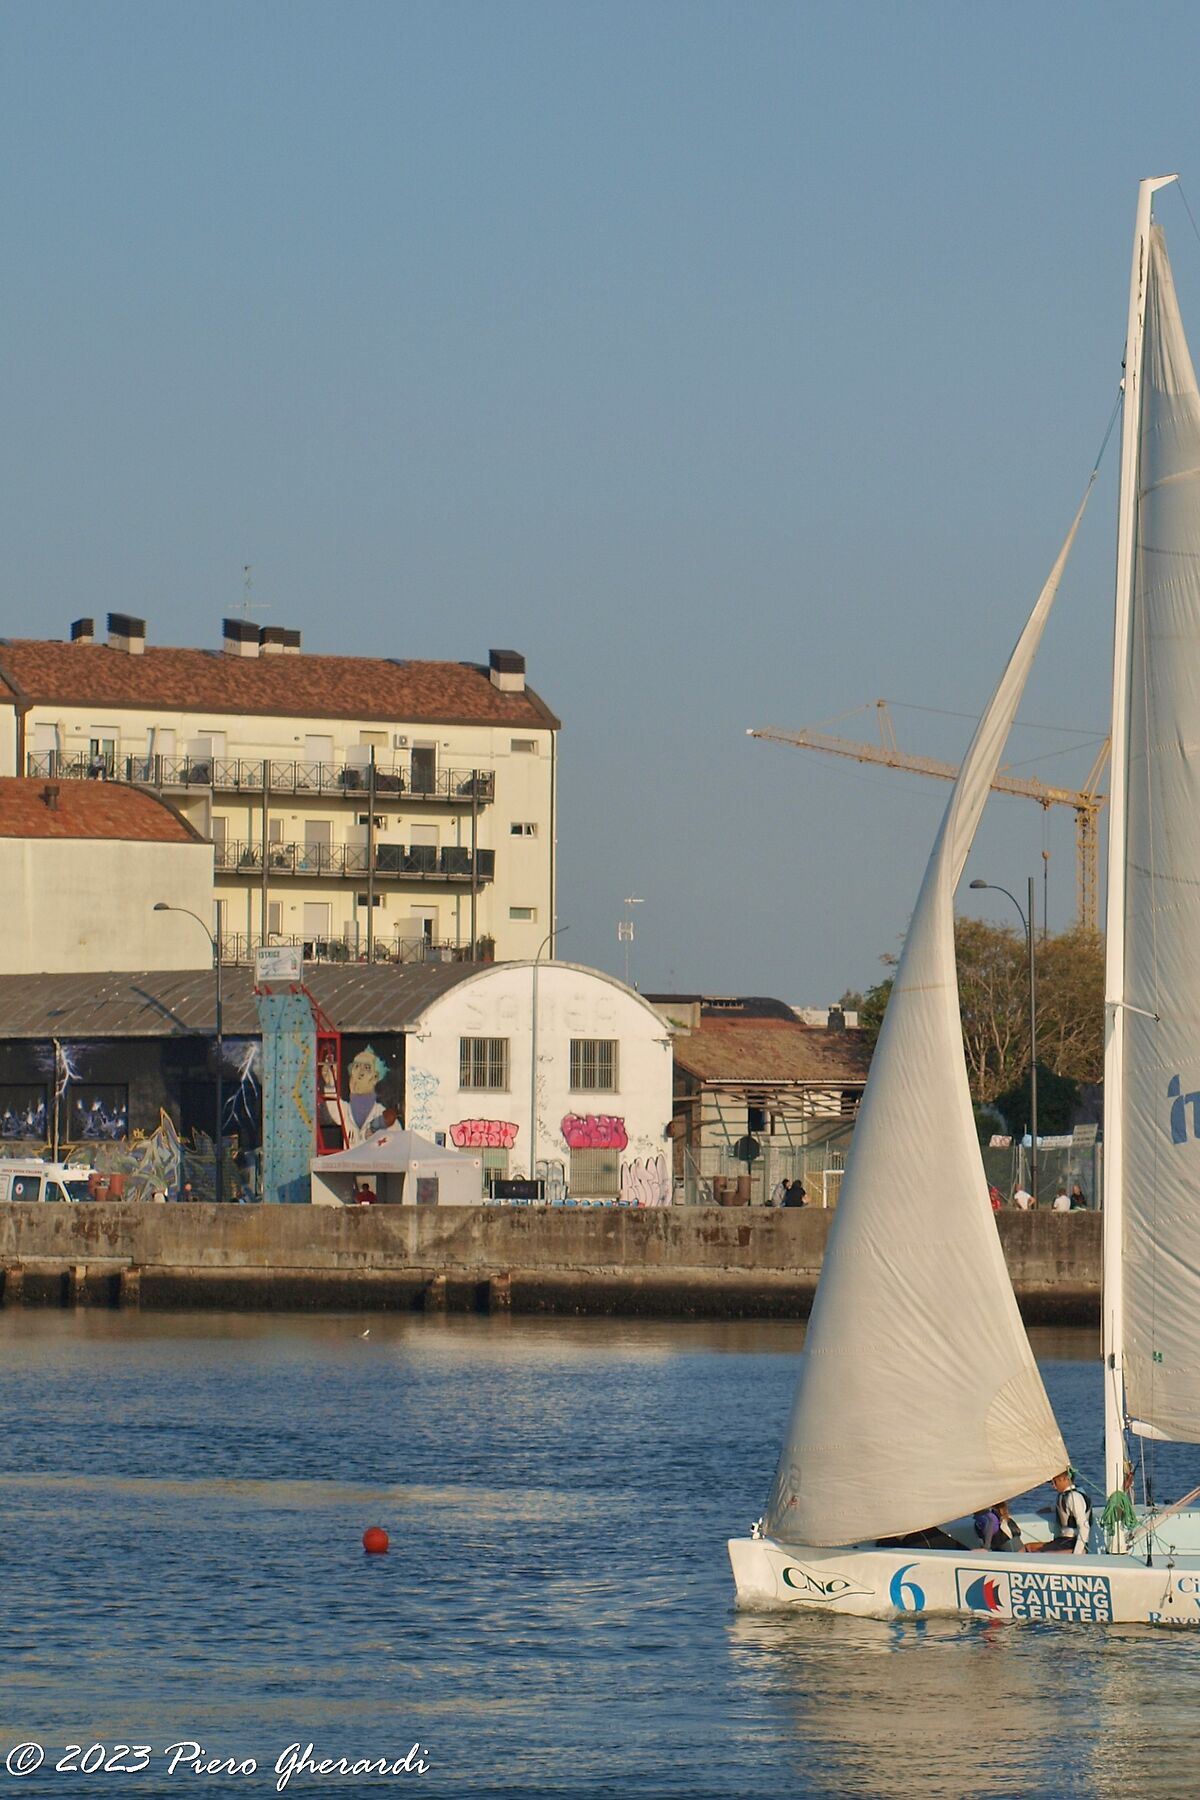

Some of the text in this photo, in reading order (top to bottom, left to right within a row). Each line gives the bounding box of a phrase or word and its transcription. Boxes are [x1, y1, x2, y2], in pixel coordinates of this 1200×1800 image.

[890, 1562, 925, 1613] 6
[1009, 1572, 1108, 1593] RAVENNA
[1011, 1589, 1109, 1609] SAILING
[1012, 1604, 1109, 1623] CENTER
